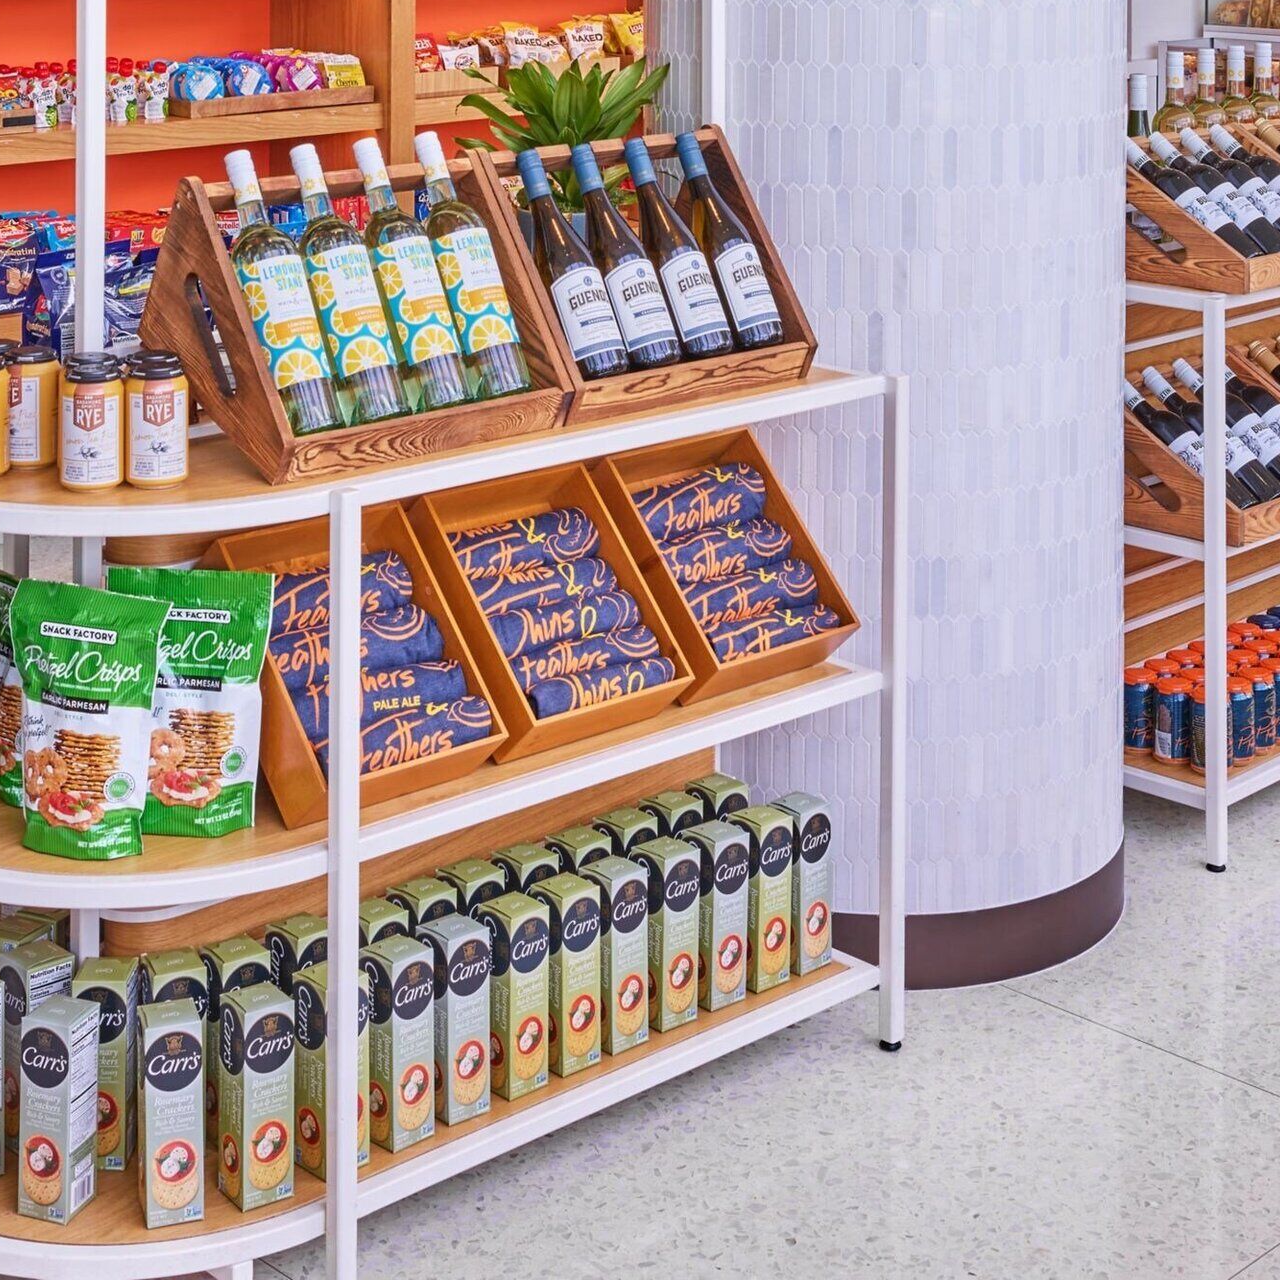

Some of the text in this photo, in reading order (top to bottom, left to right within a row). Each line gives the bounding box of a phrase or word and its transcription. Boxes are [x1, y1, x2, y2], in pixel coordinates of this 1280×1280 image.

[76, 408, 102, 426] RYE
[146, 404, 172, 421] RYE
[645, 477, 742, 540] Feathers
[660, 531, 747, 581] Feathers
[688, 576, 780, 627] Feathers
[42, 624, 72, 637] SNACK
[192, 630, 253, 669] Crisps
[24, 645, 142, 692] Pretzel Crisps
[179, 678, 221, 689] PARMESAN
[62, 699, 107, 712] PARMESAN
[373, 696, 421, 711] PALE ALE
[800, 827, 831, 852] Carr's
[761, 841, 791, 866] Carr's
[715, 858, 749, 884] Carr's
[666, 875, 700, 901] Carr's
[613, 894, 647, 921] Carr's
[563, 914, 601, 940] Carr's
[512, 933, 549, 961] Carr's
[450, 957, 490, 985] Carr's
[394, 978, 433, 1008] Carr's
[247, 1031, 293, 1060] Carr's
[22, 1046, 68, 1073] Carr's
[147, 1049, 202, 1077] Carr's
